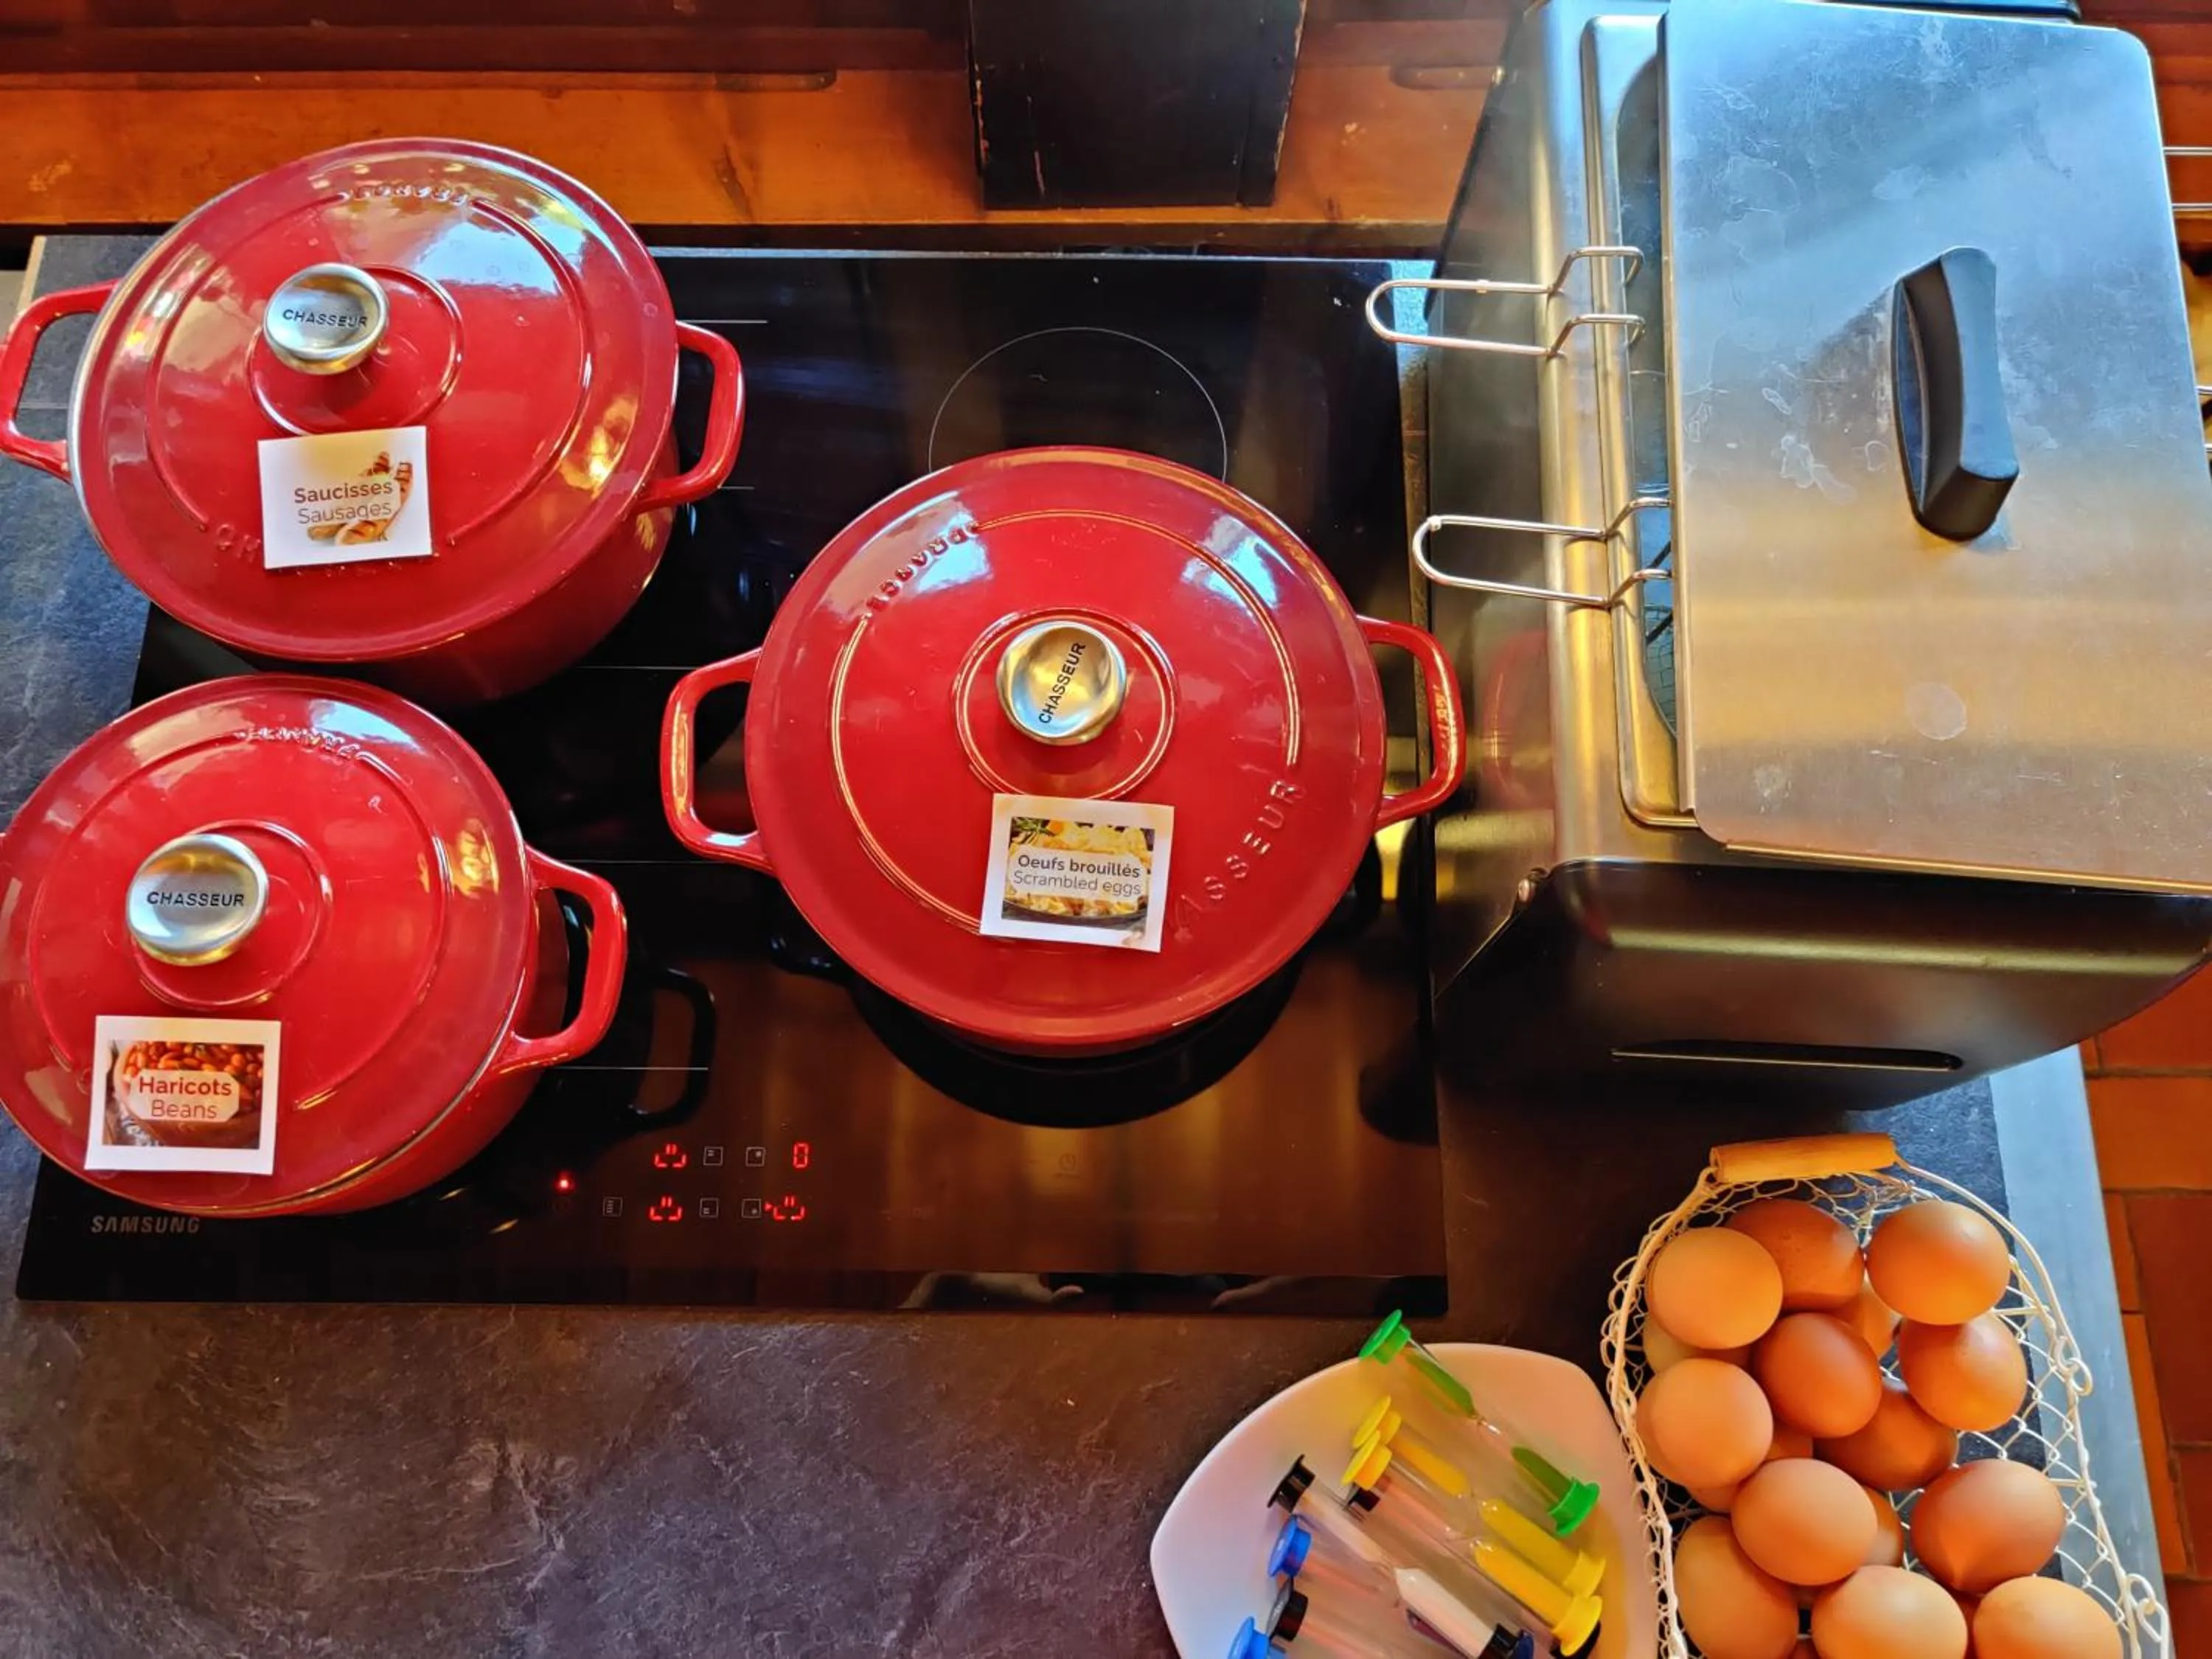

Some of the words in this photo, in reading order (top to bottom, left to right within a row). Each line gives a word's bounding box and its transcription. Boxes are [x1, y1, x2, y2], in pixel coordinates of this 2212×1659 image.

[283, 309, 368, 327] CHASSEUR
[294, 480, 393, 504] Saucisses
[297, 501, 392, 524] Sausages
[1038, 641, 1086, 724] CHASSEUR
[1018, 855, 1065, 871] Oeufs
[1070, 858, 1141, 878] brouillés
[1014, 870, 1098, 891] Scrambled
[1102, 881, 1141, 897] eggs
[147, 891, 244, 907] CHASSEUR
[139, 1076, 232, 1096] Haricots
[151, 1099, 218, 1119] Beans
[91, 1215, 201, 1234] SAMSUNG
